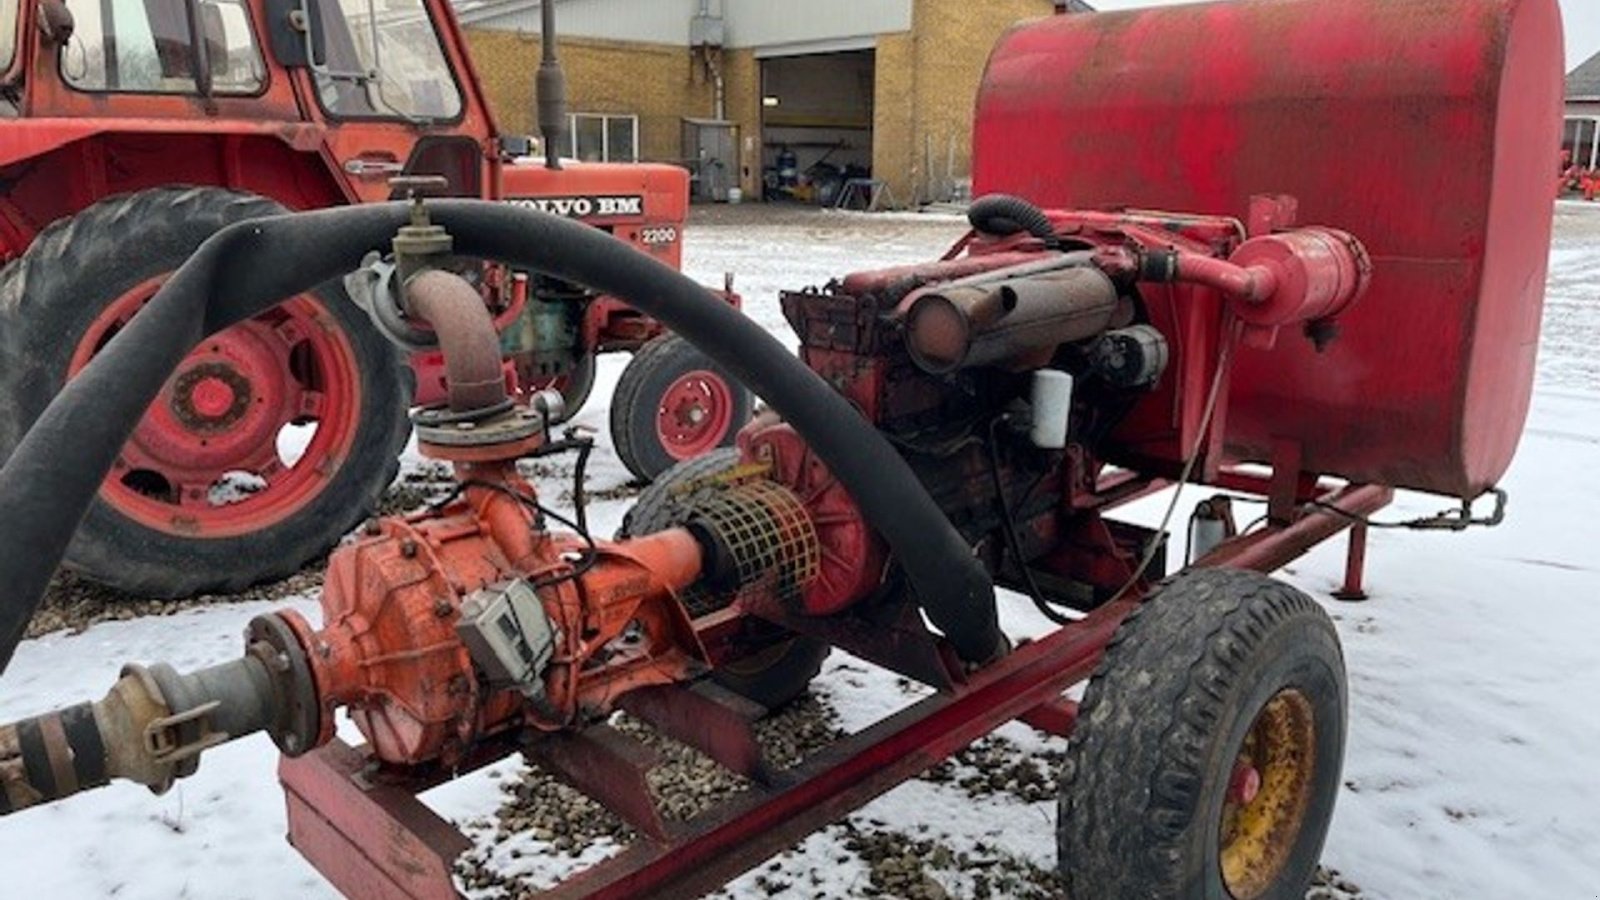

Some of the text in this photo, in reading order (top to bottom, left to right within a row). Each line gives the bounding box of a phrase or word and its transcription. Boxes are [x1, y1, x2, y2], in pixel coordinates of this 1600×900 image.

[503, 198, 641, 215] OLVO BM
[642, 228, 676, 243] 2200
